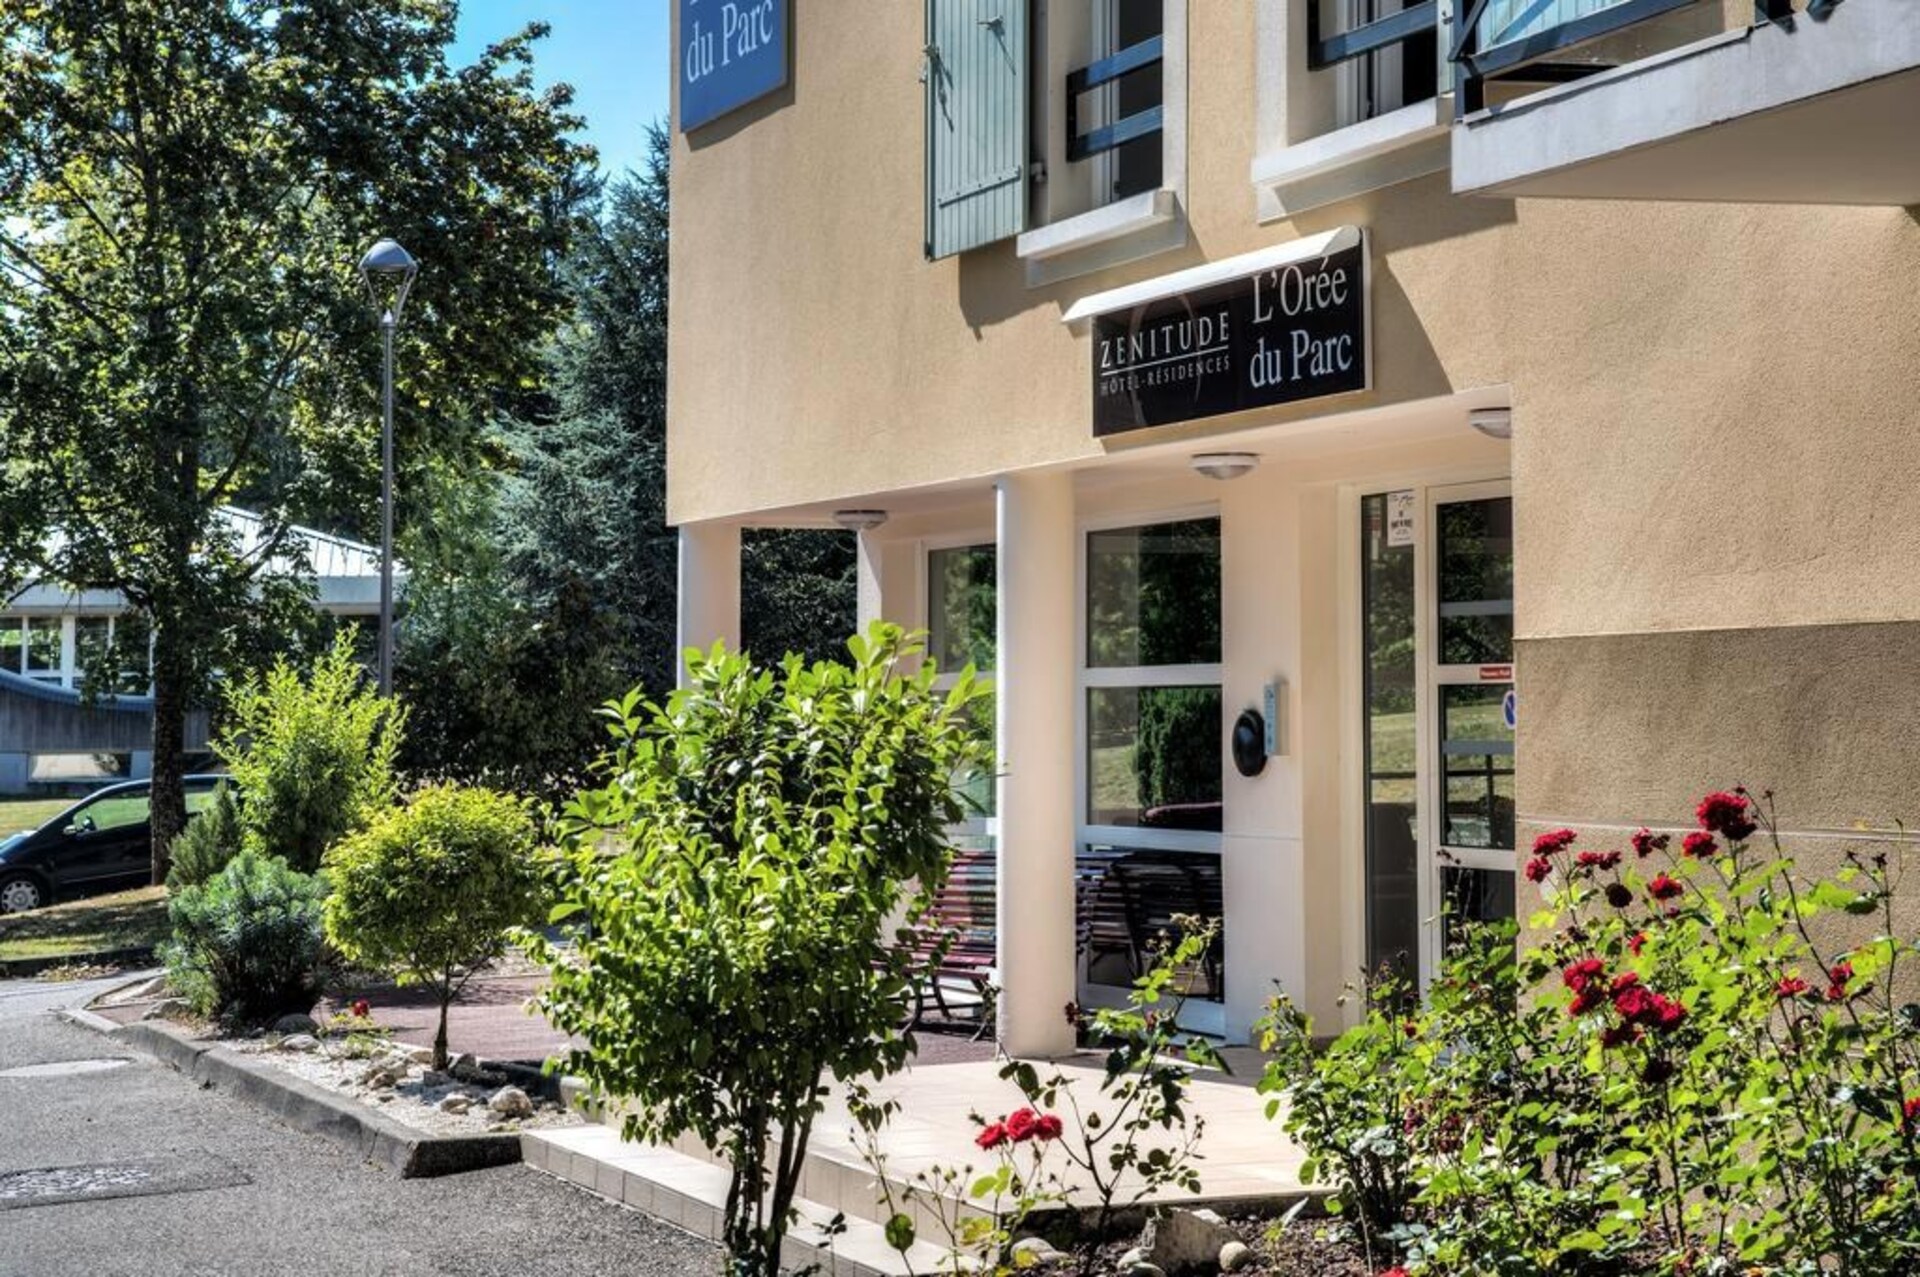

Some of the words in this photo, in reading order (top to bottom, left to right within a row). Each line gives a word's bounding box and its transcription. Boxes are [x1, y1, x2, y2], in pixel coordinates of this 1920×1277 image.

[686, 21, 714, 83] du
[721, 0, 774, 66] Parc
[1252, 256, 1348, 324] L'Orée
[1100, 311, 1230, 368] ZENITUDE
[1250, 337, 1282, 388] du
[1290, 329, 1353, 381] Parc
